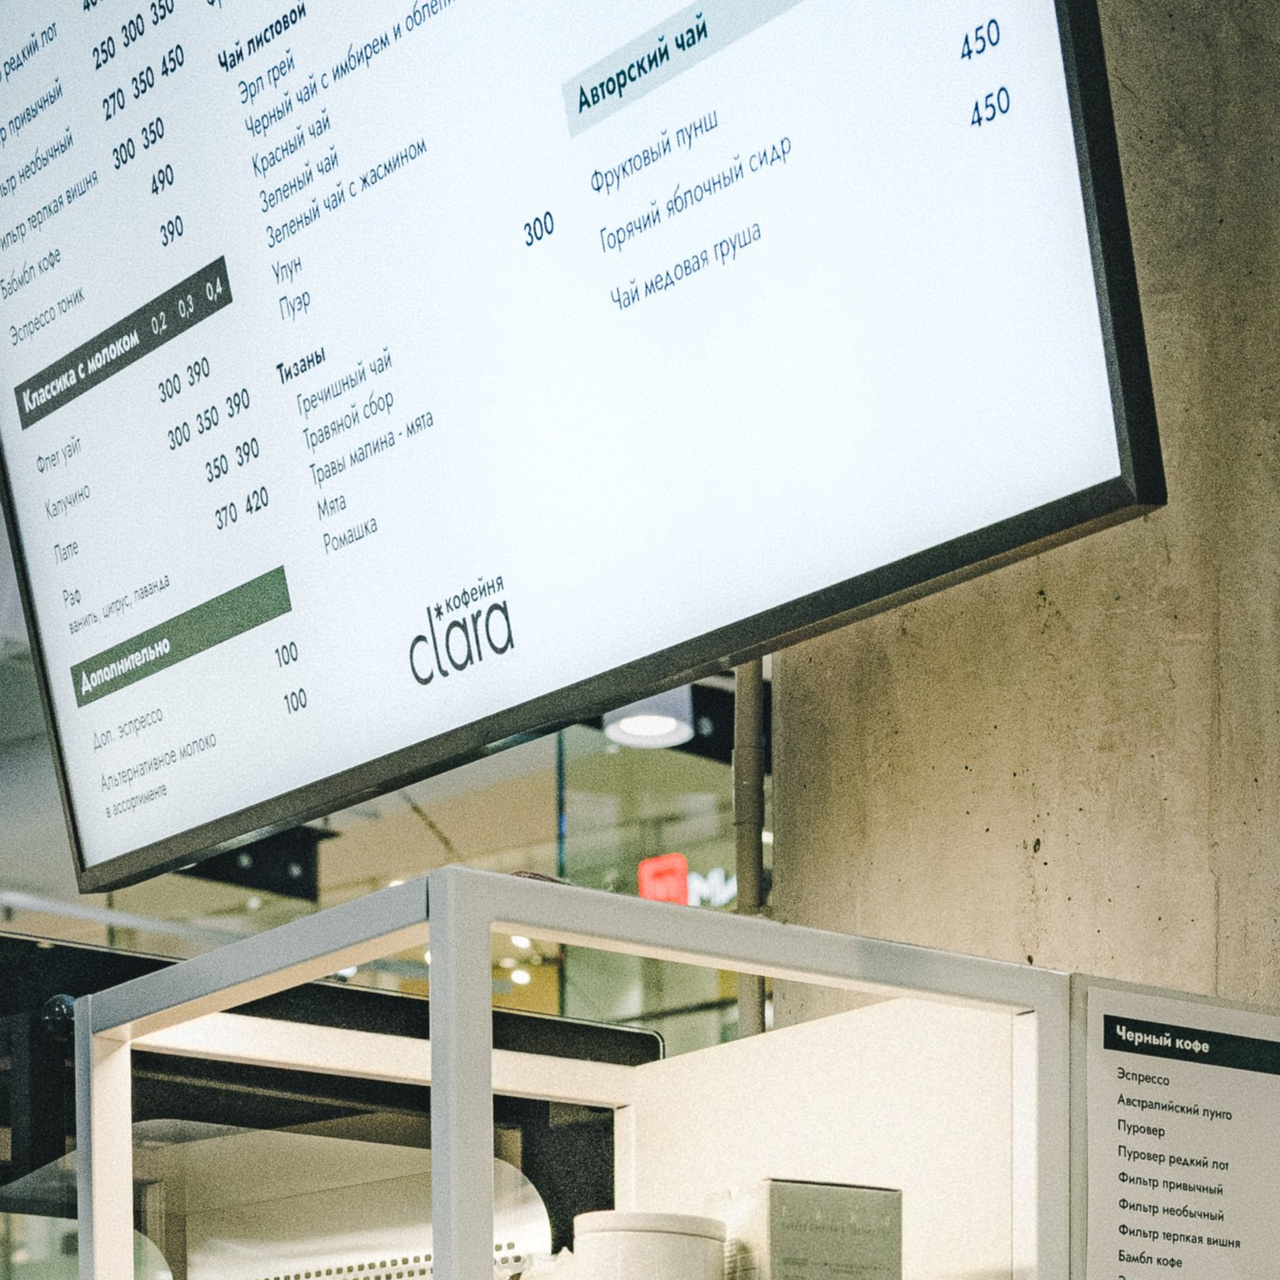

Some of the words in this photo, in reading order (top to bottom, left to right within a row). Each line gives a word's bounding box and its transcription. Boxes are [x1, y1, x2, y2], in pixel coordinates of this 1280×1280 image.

[961, 19, 1000, 59] 450
[238, 76, 264, 104] Эрл
[267, 56, 295, 88] грей
[579, 37, 669, 113] Авторский
[675, 22, 707, 51] чай
[971, 87, 1010, 126] 450
[591, 130, 671, 195] Фруктовый
[676, 111, 718, 149] пунш
[600, 201, 661, 252] Горячий
[667, 163, 744, 217] яблочный
[749, 137, 791, 172] сидр
[611, 280, 640, 310] Чай
[645, 250, 708, 297] медовая
[714, 223, 761, 265] груша
[22, 369, 76, 411] Классика
[88, 330, 139, 373] молоком
[152, 312, 167, 334] 0,2
[178, 295, 194, 317] 0,3
[206, 278, 222, 300] 0,4
[276, 348, 325, 384] Тизаны
[297, 361, 366, 418] Гречишный
[370, 347, 394, 377] чай
[302, 411, 359, 452] Травяной
[364, 392, 394, 419] сбор
[309, 458, 346, 488] Травы
[350, 431, 395, 466] малина
[406, 412, 434, 437] мята
[323, 518, 378, 553] Ромашка
[444, 576, 506, 611] кофейня
[275, 641, 298, 667] 100
[410, 600, 515, 686] clara
[83, 639, 170, 692] Дополнительно
[284, 688, 307, 713] 100
[1115, 1025, 1172, 1047] Черный
[1175, 1038, 1210, 1053] кофе
[1117, 1066, 1171, 1087] Эспрессо
[1116, 1093, 1200, 1116] Австралийский
[1202, 1108, 1233, 1121] лунго
[1117, 1171, 1160, 1190] Фильтр
[1162, 1179, 1224, 1196] привычный
[1118, 1197, 1160, 1217] Фильтр
[1161, 1204, 1225, 1222] необычный
[1117, 1223, 1160, 1242] Фильтр
[1162, 1231, 1204, 1245] терпкая
[1206, 1236, 1241, 1249] вишня
